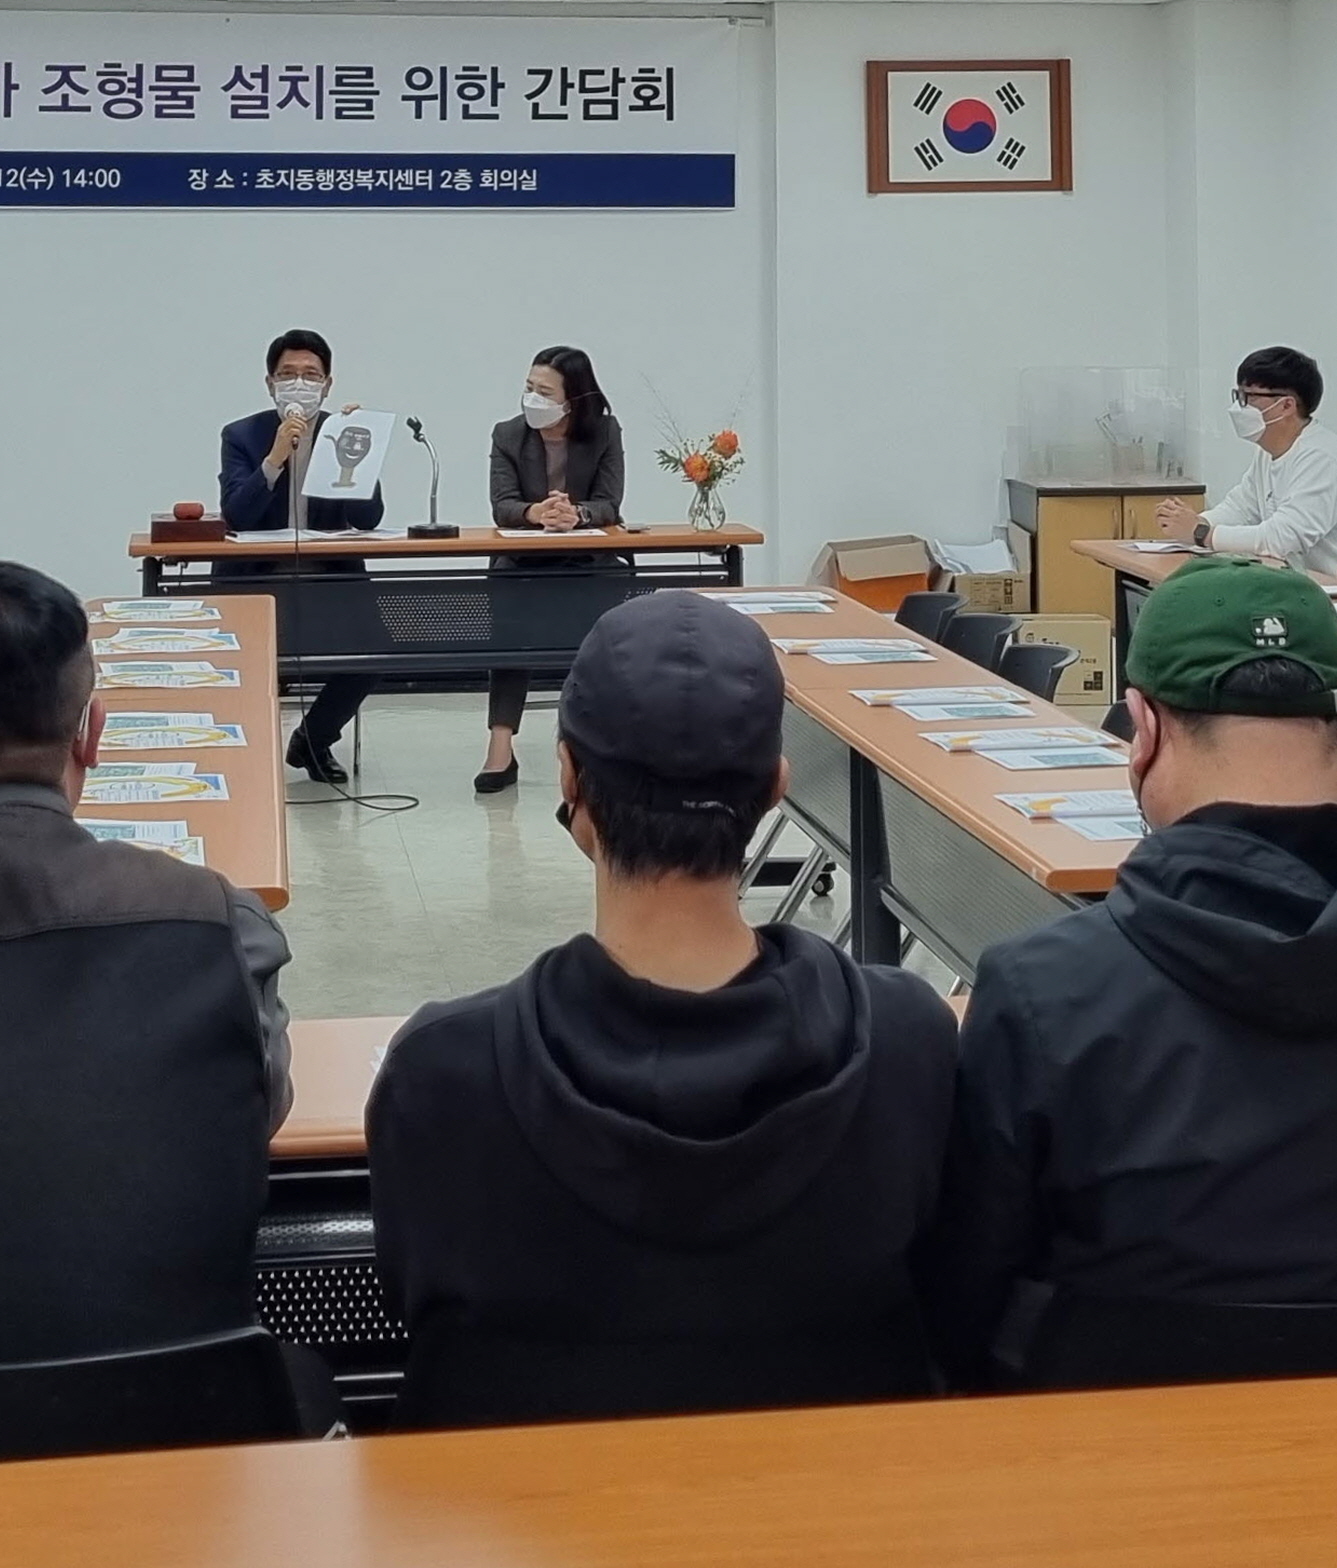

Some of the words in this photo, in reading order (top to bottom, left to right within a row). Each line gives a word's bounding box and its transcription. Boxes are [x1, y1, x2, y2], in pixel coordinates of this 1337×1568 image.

[38, 62, 201, 120] 조형물
[220, 64, 381, 121] 설치를
[400, 65, 506, 121] 위한
[524, 66, 676, 122] 간담회
[62, 168, 121, 188] 14:00
[187, 168, 210, 191] 장
[213, 169, 235, 189] 소
[254, 168, 433, 192] 초지동행정복지센터
[439, 168, 474, 192] 2층
[479, 168, 538, 191] 회의실
[1255, 636, 1287, 647] MLB
